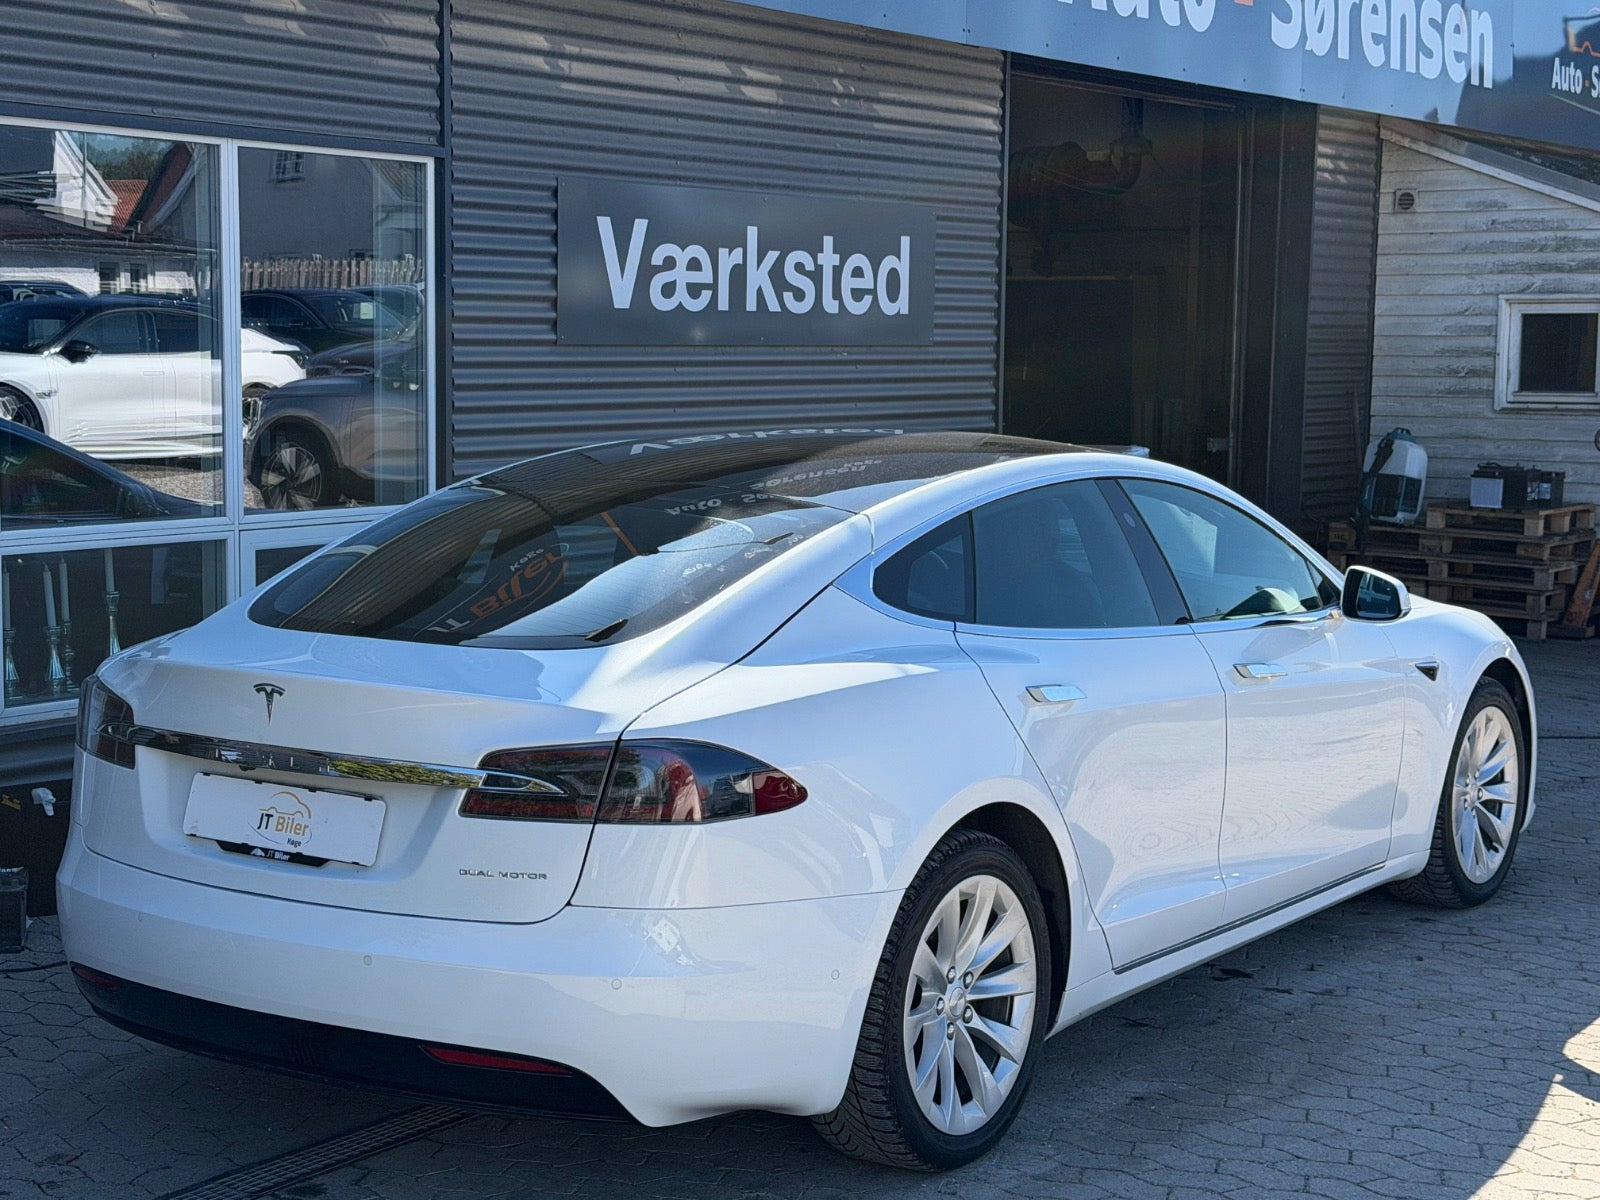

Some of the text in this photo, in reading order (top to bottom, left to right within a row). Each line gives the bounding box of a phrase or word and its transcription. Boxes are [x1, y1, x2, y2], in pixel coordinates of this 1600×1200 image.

[1551, 57, 1583, 95] Auto
[596, 215, 911, 316] Værksted
[257, 812, 310, 837] JT Biler
[458, 868, 548, 880] DUAL MOTOR
